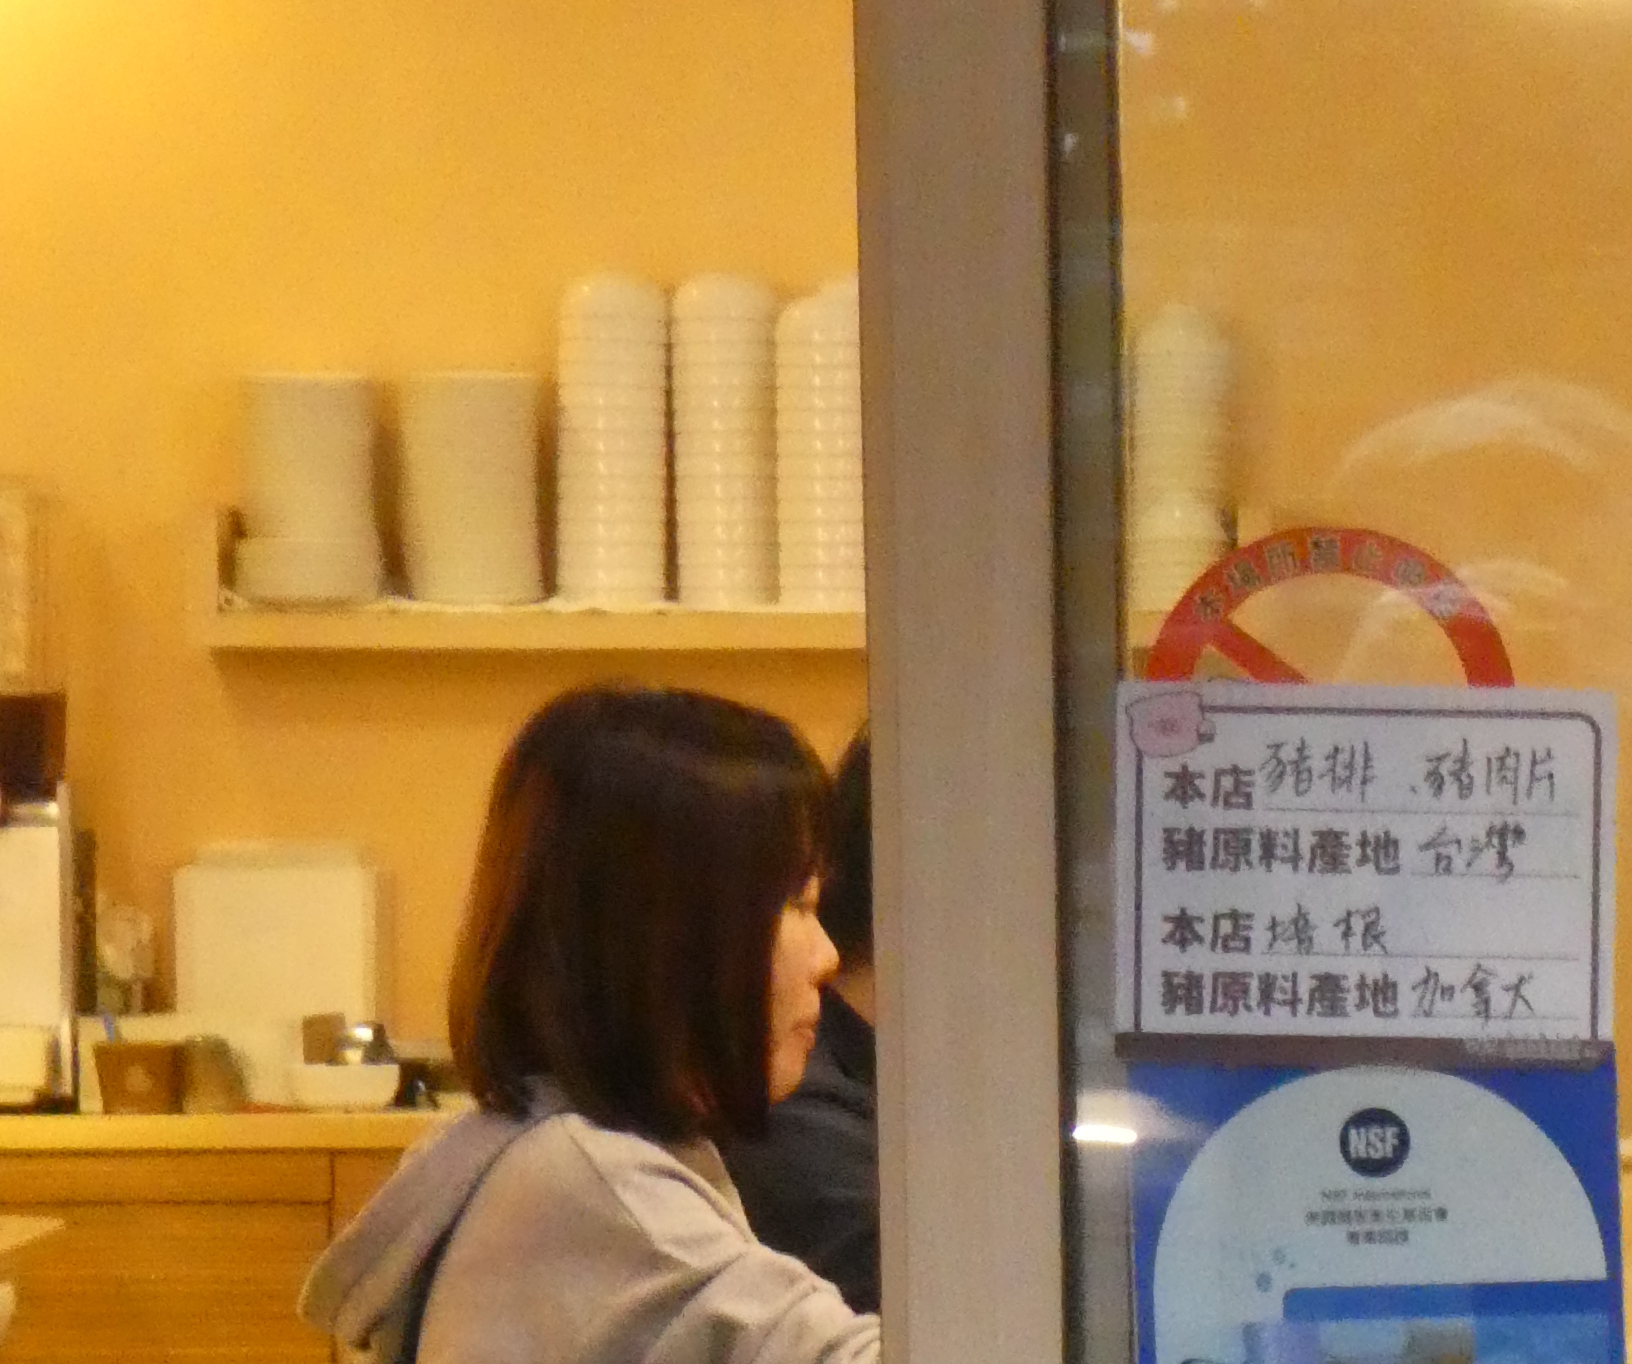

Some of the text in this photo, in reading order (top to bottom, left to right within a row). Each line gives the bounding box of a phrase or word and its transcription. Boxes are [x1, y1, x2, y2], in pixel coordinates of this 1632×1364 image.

[1163, 761, 1256, 812] 本店
[1161, 824, 1402, 876] 豬原料產地
[1160, 905, 1256, 956] 本店
[1160, 970, 1400, 1019] 豬原料產地
[1348, 1125, 1402, 1160] NSF
